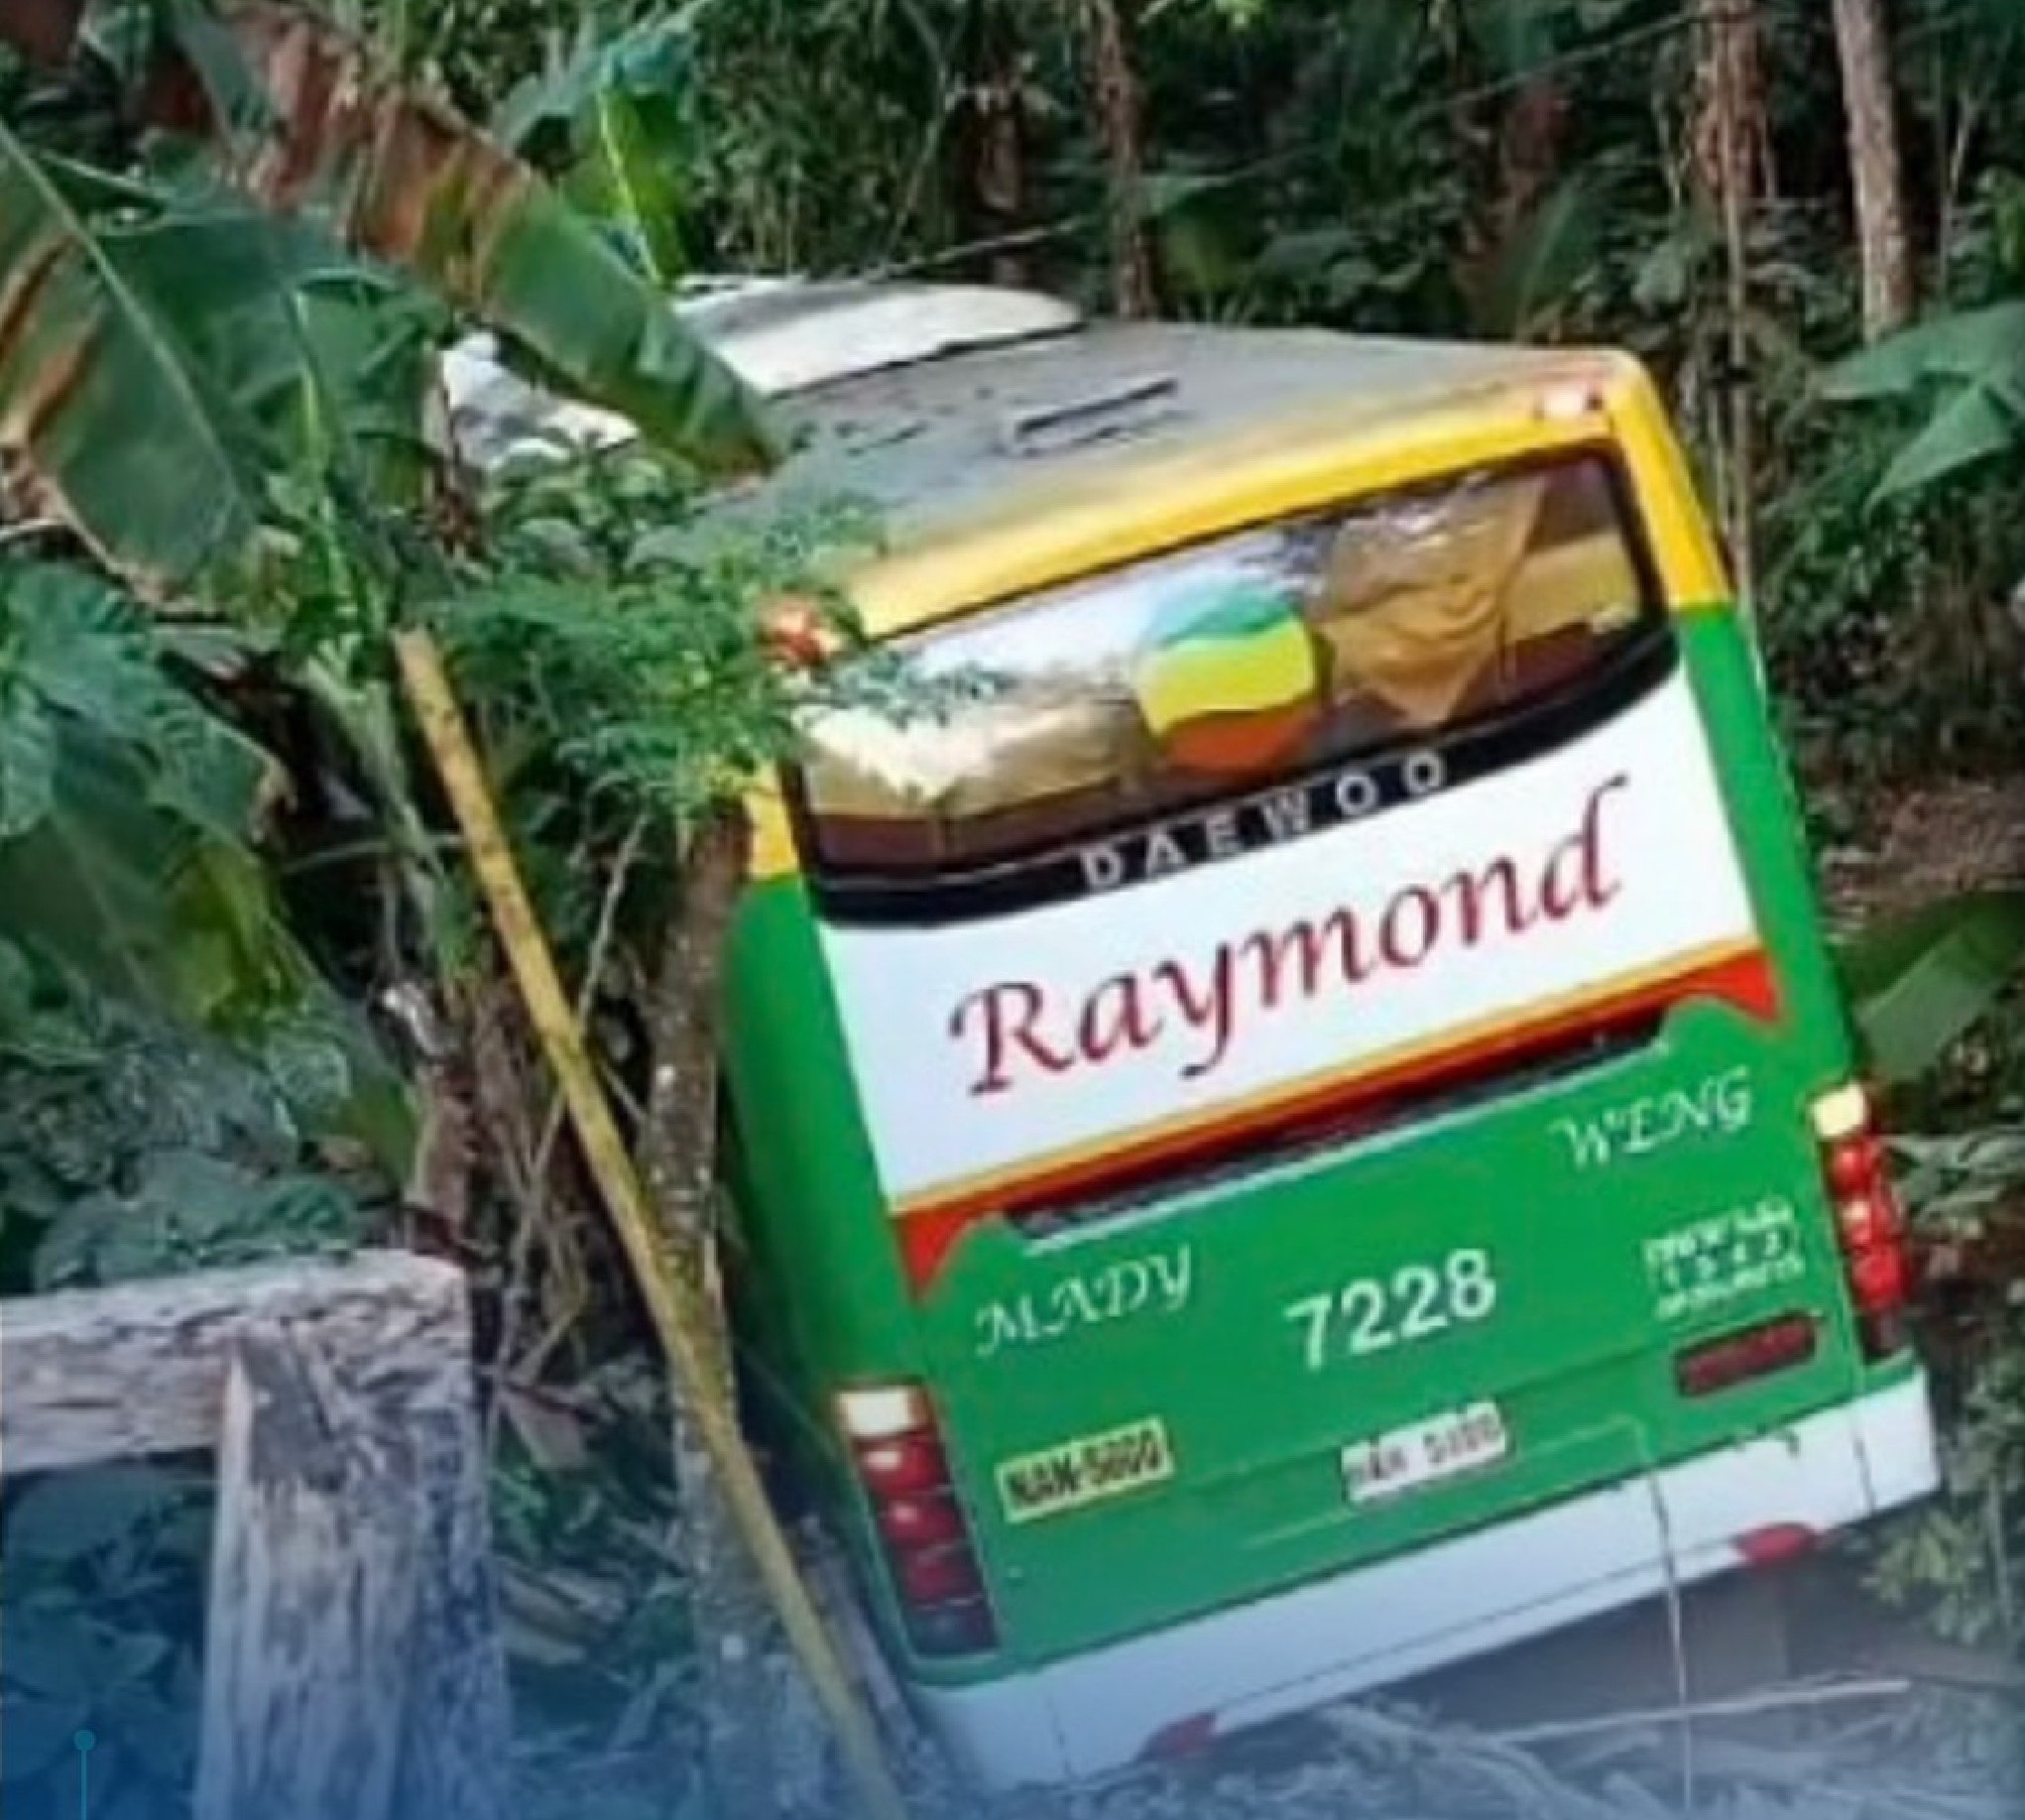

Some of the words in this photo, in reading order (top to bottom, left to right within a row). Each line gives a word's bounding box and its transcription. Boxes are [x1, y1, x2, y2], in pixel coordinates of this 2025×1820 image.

[1080, 750, 1445, 891] DAEWOO
[947, 772, 1628, 1096] Raymond
[1547, 1065, 1751, 1167] WENG
[975, 1244, 1190, 1356] MADY
[1284, 1248, 1496, 1371] 7228
